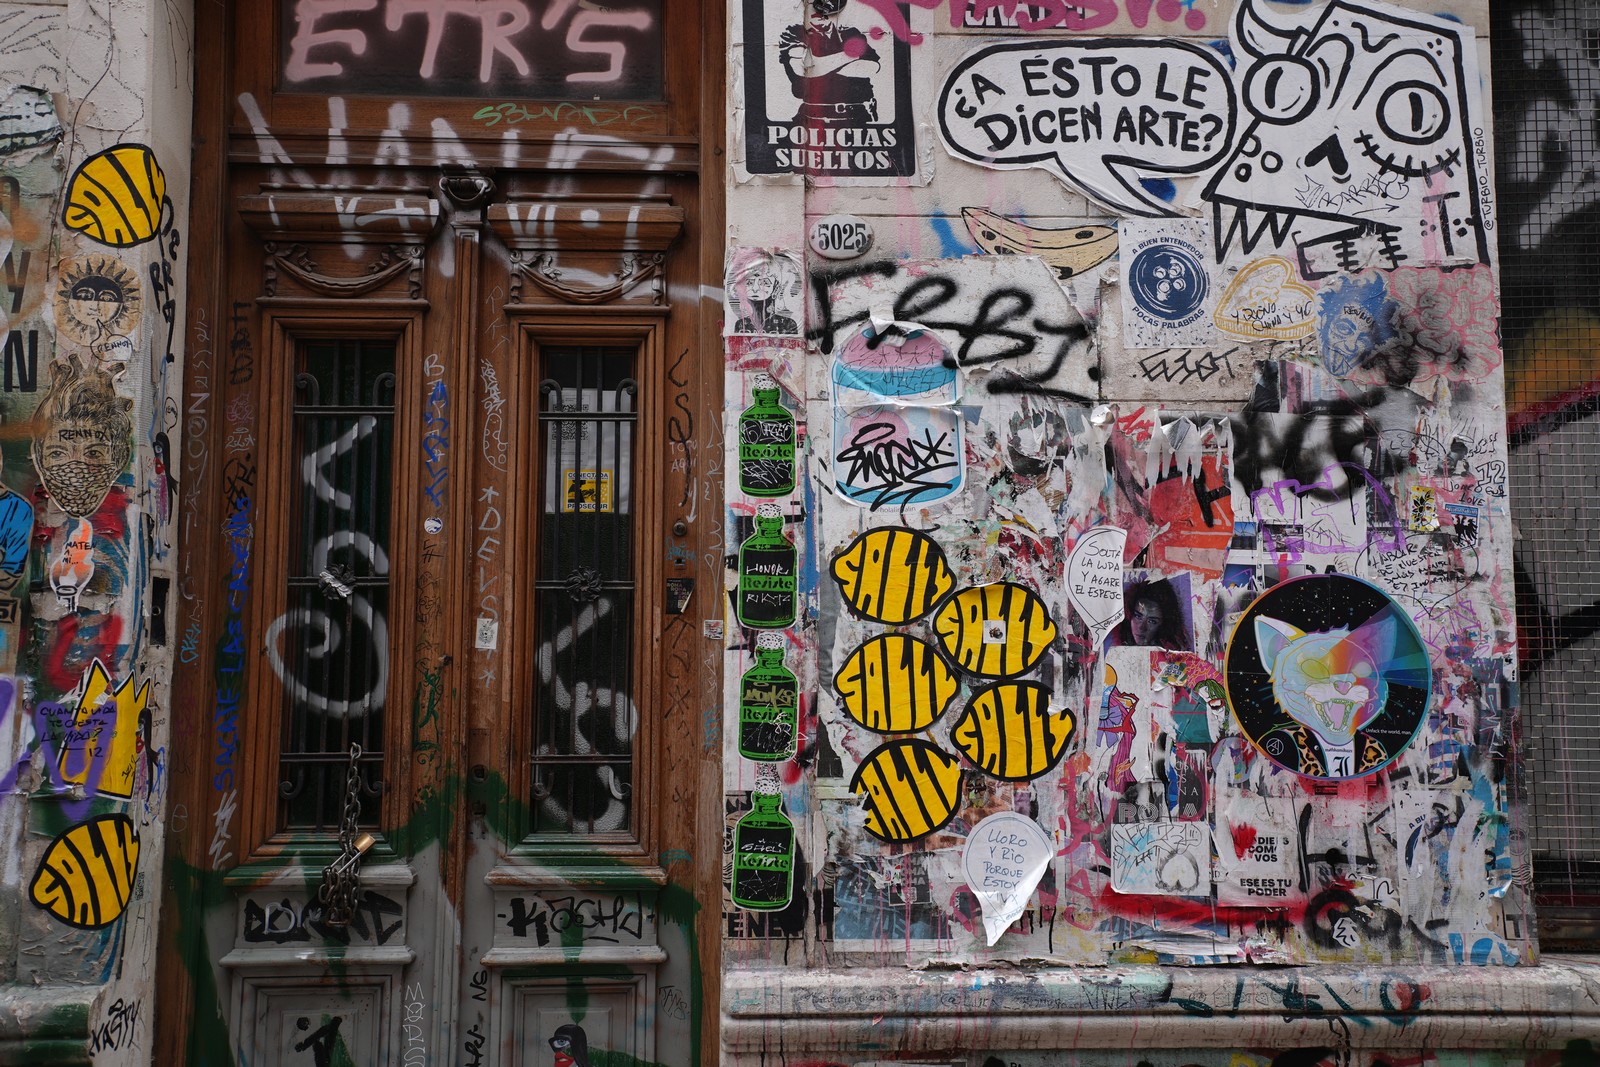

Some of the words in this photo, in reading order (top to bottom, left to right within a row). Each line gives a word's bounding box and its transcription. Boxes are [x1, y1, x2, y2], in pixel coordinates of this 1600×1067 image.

[1155, 62, 1212, 110] LE
[767, 125, 898, 148] POLICIAS
[1113, 104, 1223, 153] ARTE?
[775, 148, 893, 171] SUELTOS
[817, 222, 868, 251] 5025
[1131, 247, 1139, 256] A
[1138, 236, 1158, 250] BUEN
[1160, 236, 1205, 261] ENTENDEDOR
[1131, 306, 1159, 327] POCAS
[1161, 308, 1206, 329] PALABRAS
[1081, 557, 1094, 568] LA
[1081, 570, 1090, 583] Y
[1074, 585, 1086, 595] EL
[989, 846, 997, 859] Y
[1254, 854, 1278, 862] VOS
[983, 861, 1024, 878] PORQUE
[982, 875, 1020, 891] ESTOY
[1240, 878, 1260, 887] ESE
[1261, 879, 1276, 887] ES
[1276, 879, 1292, 888] TU
[1247, 888, 1287, 897] PODER
